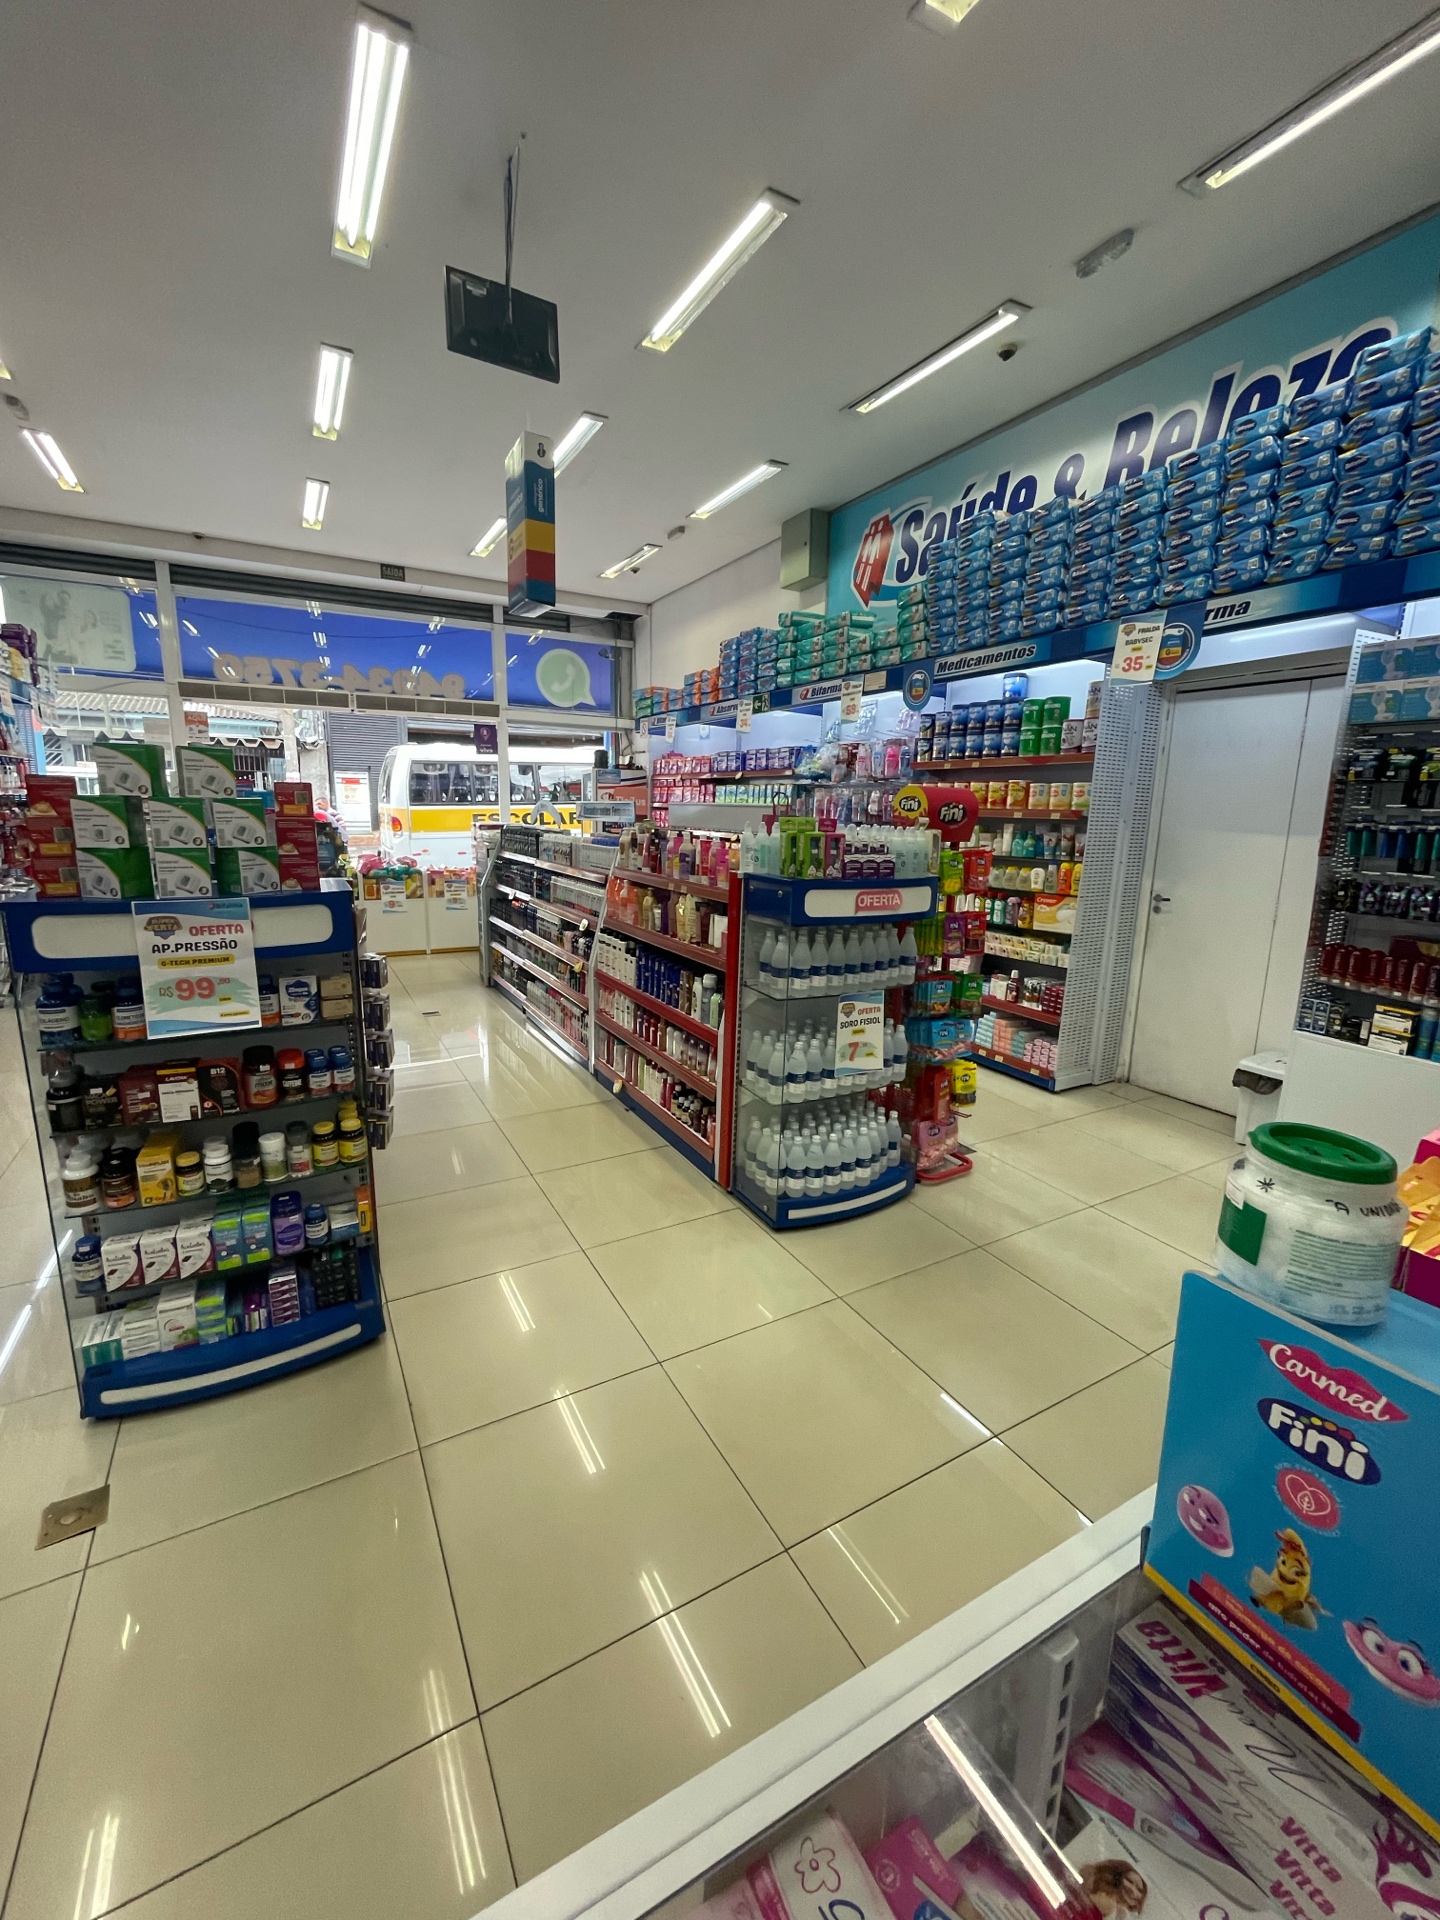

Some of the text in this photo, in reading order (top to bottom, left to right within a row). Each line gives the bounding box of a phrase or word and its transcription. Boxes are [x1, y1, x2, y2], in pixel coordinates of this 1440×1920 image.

[896, 470, 1038, 584] Saúde
[1054, 453, 1088, 502] &
[382, 566, 404, 579] SAÍDA
[936, 644, 1037, 675] Medicamentos
[1121, 655, 1144, 673] 35
[480, 747, 494, 755] vivo
[900, 798, 919, 811] Fini
[939, 803, 964, 822] Fini
[472, 812, 584, 826] ESCOLAR
[858, 894, 900, 907] OFERTA
[188, 923, 245, 937] OFERTA
[151, 937, 239, 954] AP.PRESSÃO
[160, 956, 231, 967] G-TECH PREMIUM
[175, 976, 216, 1001] 99
[857, 1006, 881, 1016] OFERTA
[840, 1019, 859, 1030] SORO
[848, 1041, 860, 1062] 7
[85, 1096, 118, 1105] POWER
[1269, 1343, 1390, 1422] Carmed
[1268, 1402, 1370, 1481] Fini
[1208, 1601, 1228, 1622] alto
[1229, 1620, 1261, 1650] poder
[1135, 1620, 1230, 1698] Vitta
[1279, 1815, 1343, 1884] Vitta
[1274, 1847, 1337, 1917] Vitta
[1269, 1879, 1314, 1920] Vit
